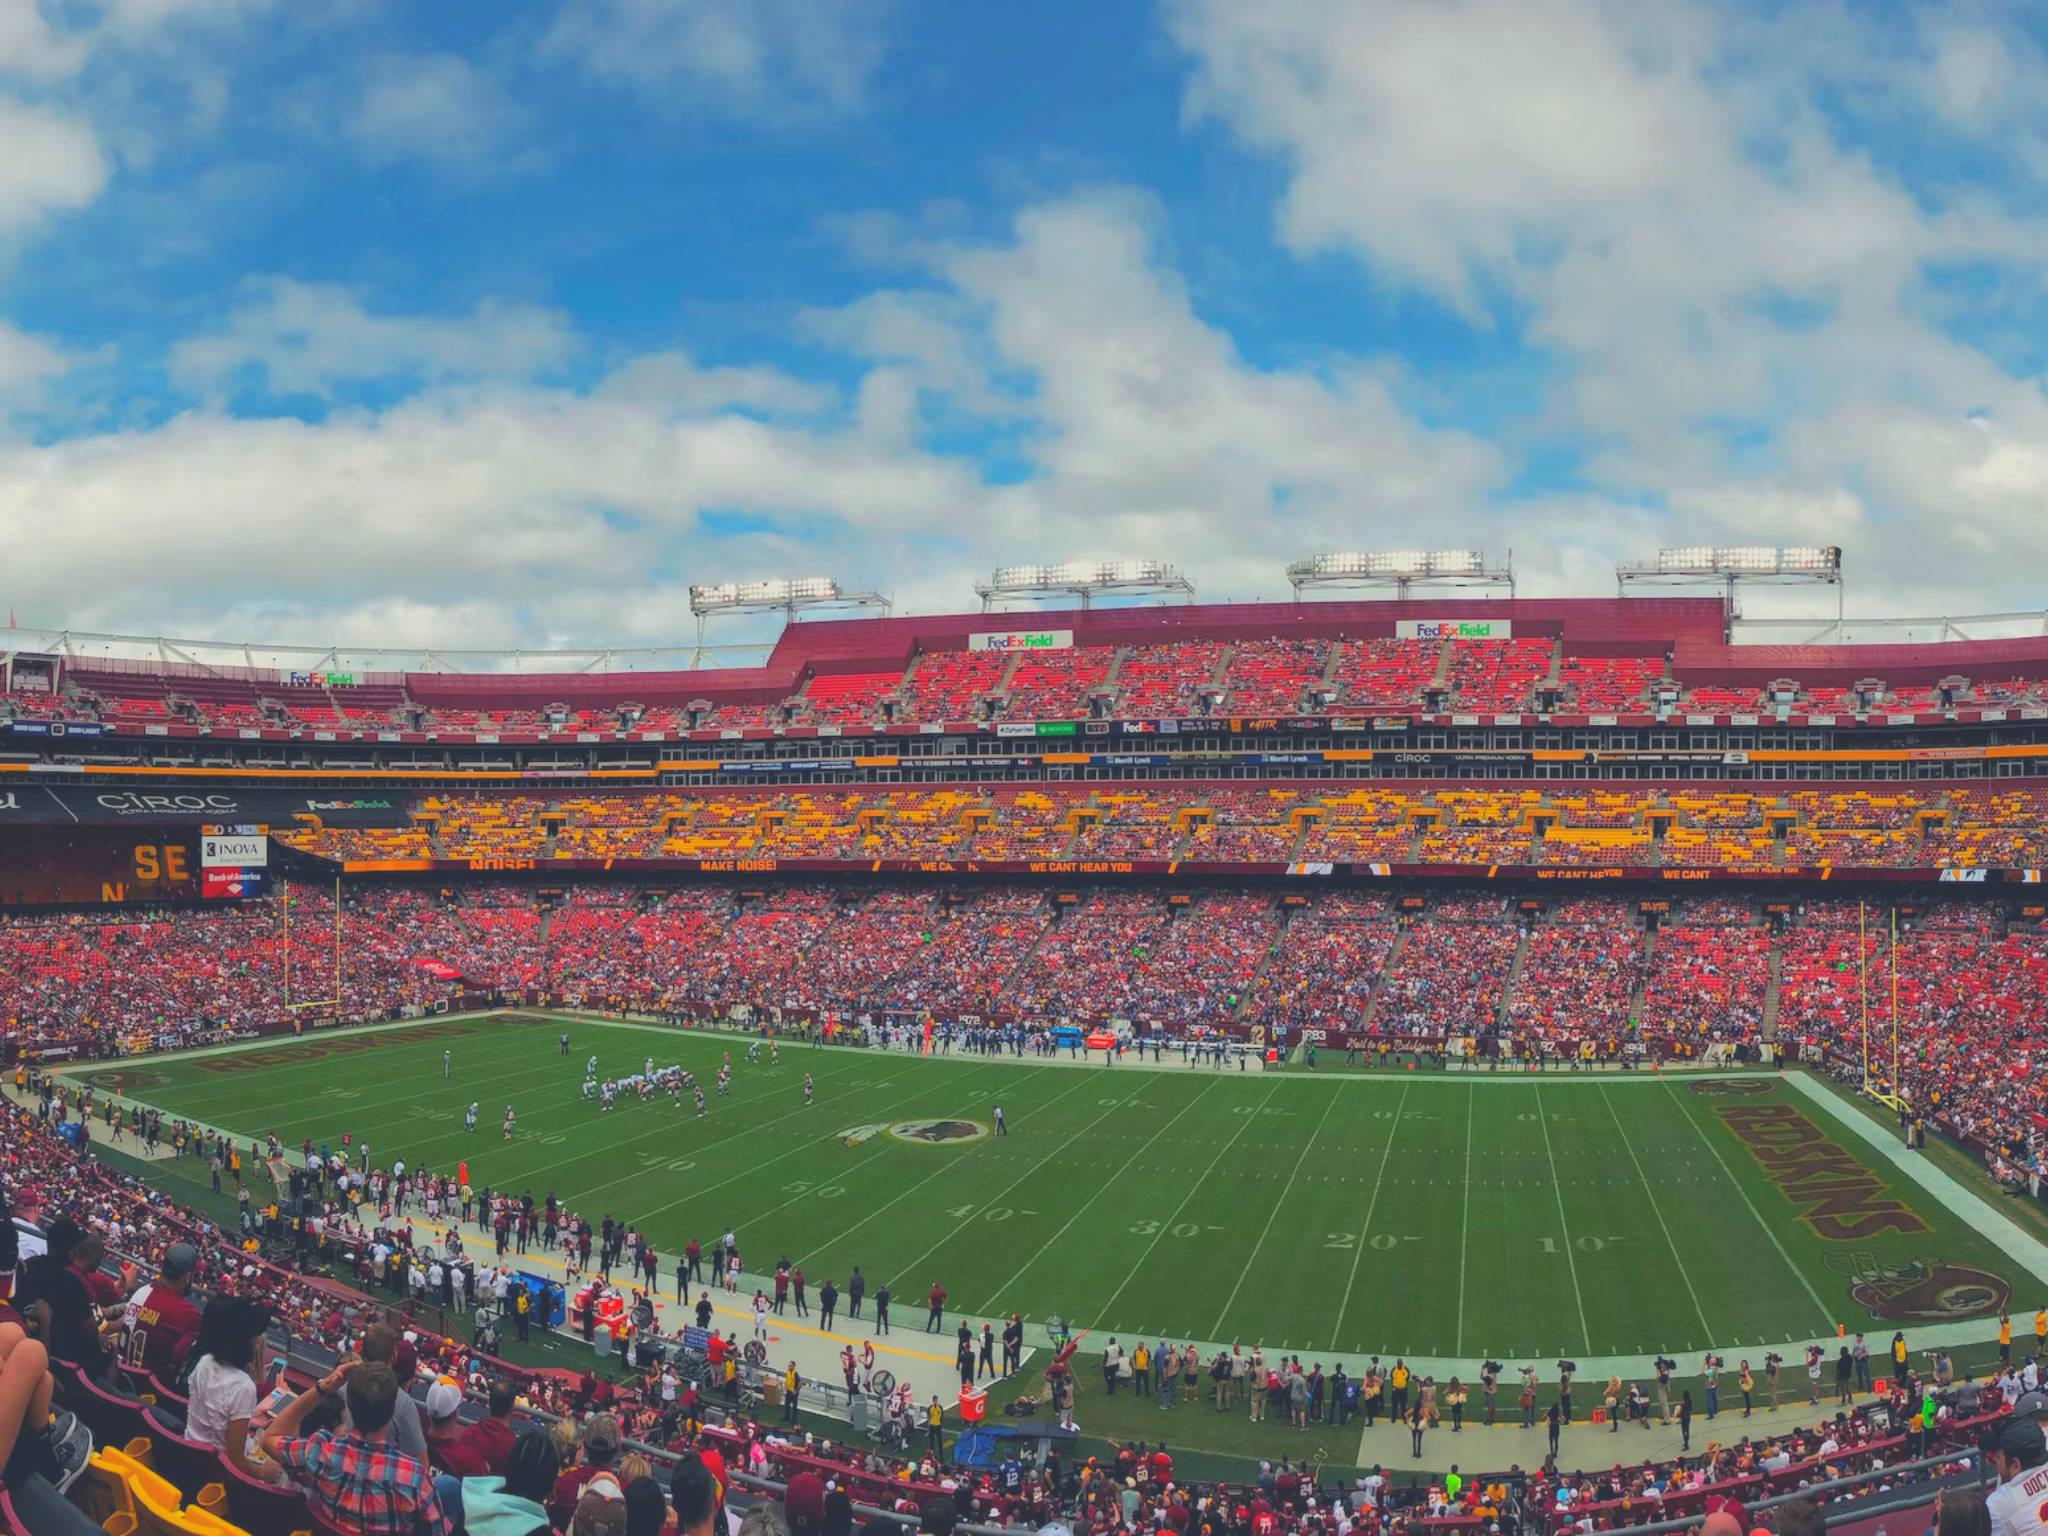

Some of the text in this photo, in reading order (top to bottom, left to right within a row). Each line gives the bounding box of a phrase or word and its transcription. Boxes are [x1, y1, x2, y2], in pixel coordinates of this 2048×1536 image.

[1417, 623, 1490, 636] FedExField
[988, 634, 1053, 648] FedExField
[291, 671, 353, 684] FedExField
[1123, 722, 1154, 733] FedEx
[306, 800, 391, 811] FedExField
[219, 843, 258, 855] INOVA
[701, 860, 776, 871] MAKE NOISE!
[921, 862, 938, 872] WE
[1030, 862, 1047, 873] WE
[1080, 862, 1108, 873] HEAR
[1110, 862, 1132, 873] YOU
[209, 873, 226, 882] Bank
[234, 872, 261, 881] America
[1604, 868, 1622, 877] YOU
[1663, 870, 1680, 879] WE
[959, 1014, 981, 1025] 1972
[1347, 1037, 1367, 1049] Hail
[186, 1026, 483, 1075] REDSKINS
[1716, 1104, 1934, 1241] REDSKINS
[781, 1181, 846, 1198] 50
[943, 1203, 1014, 1222] 40
[1129, 1219, 1200, 1238] 30
[1323, 1232, 1398, 1250] 20
[1537, 1236, 1605, 1253] 10
[1006, 1471, 1019, 1487] 12
